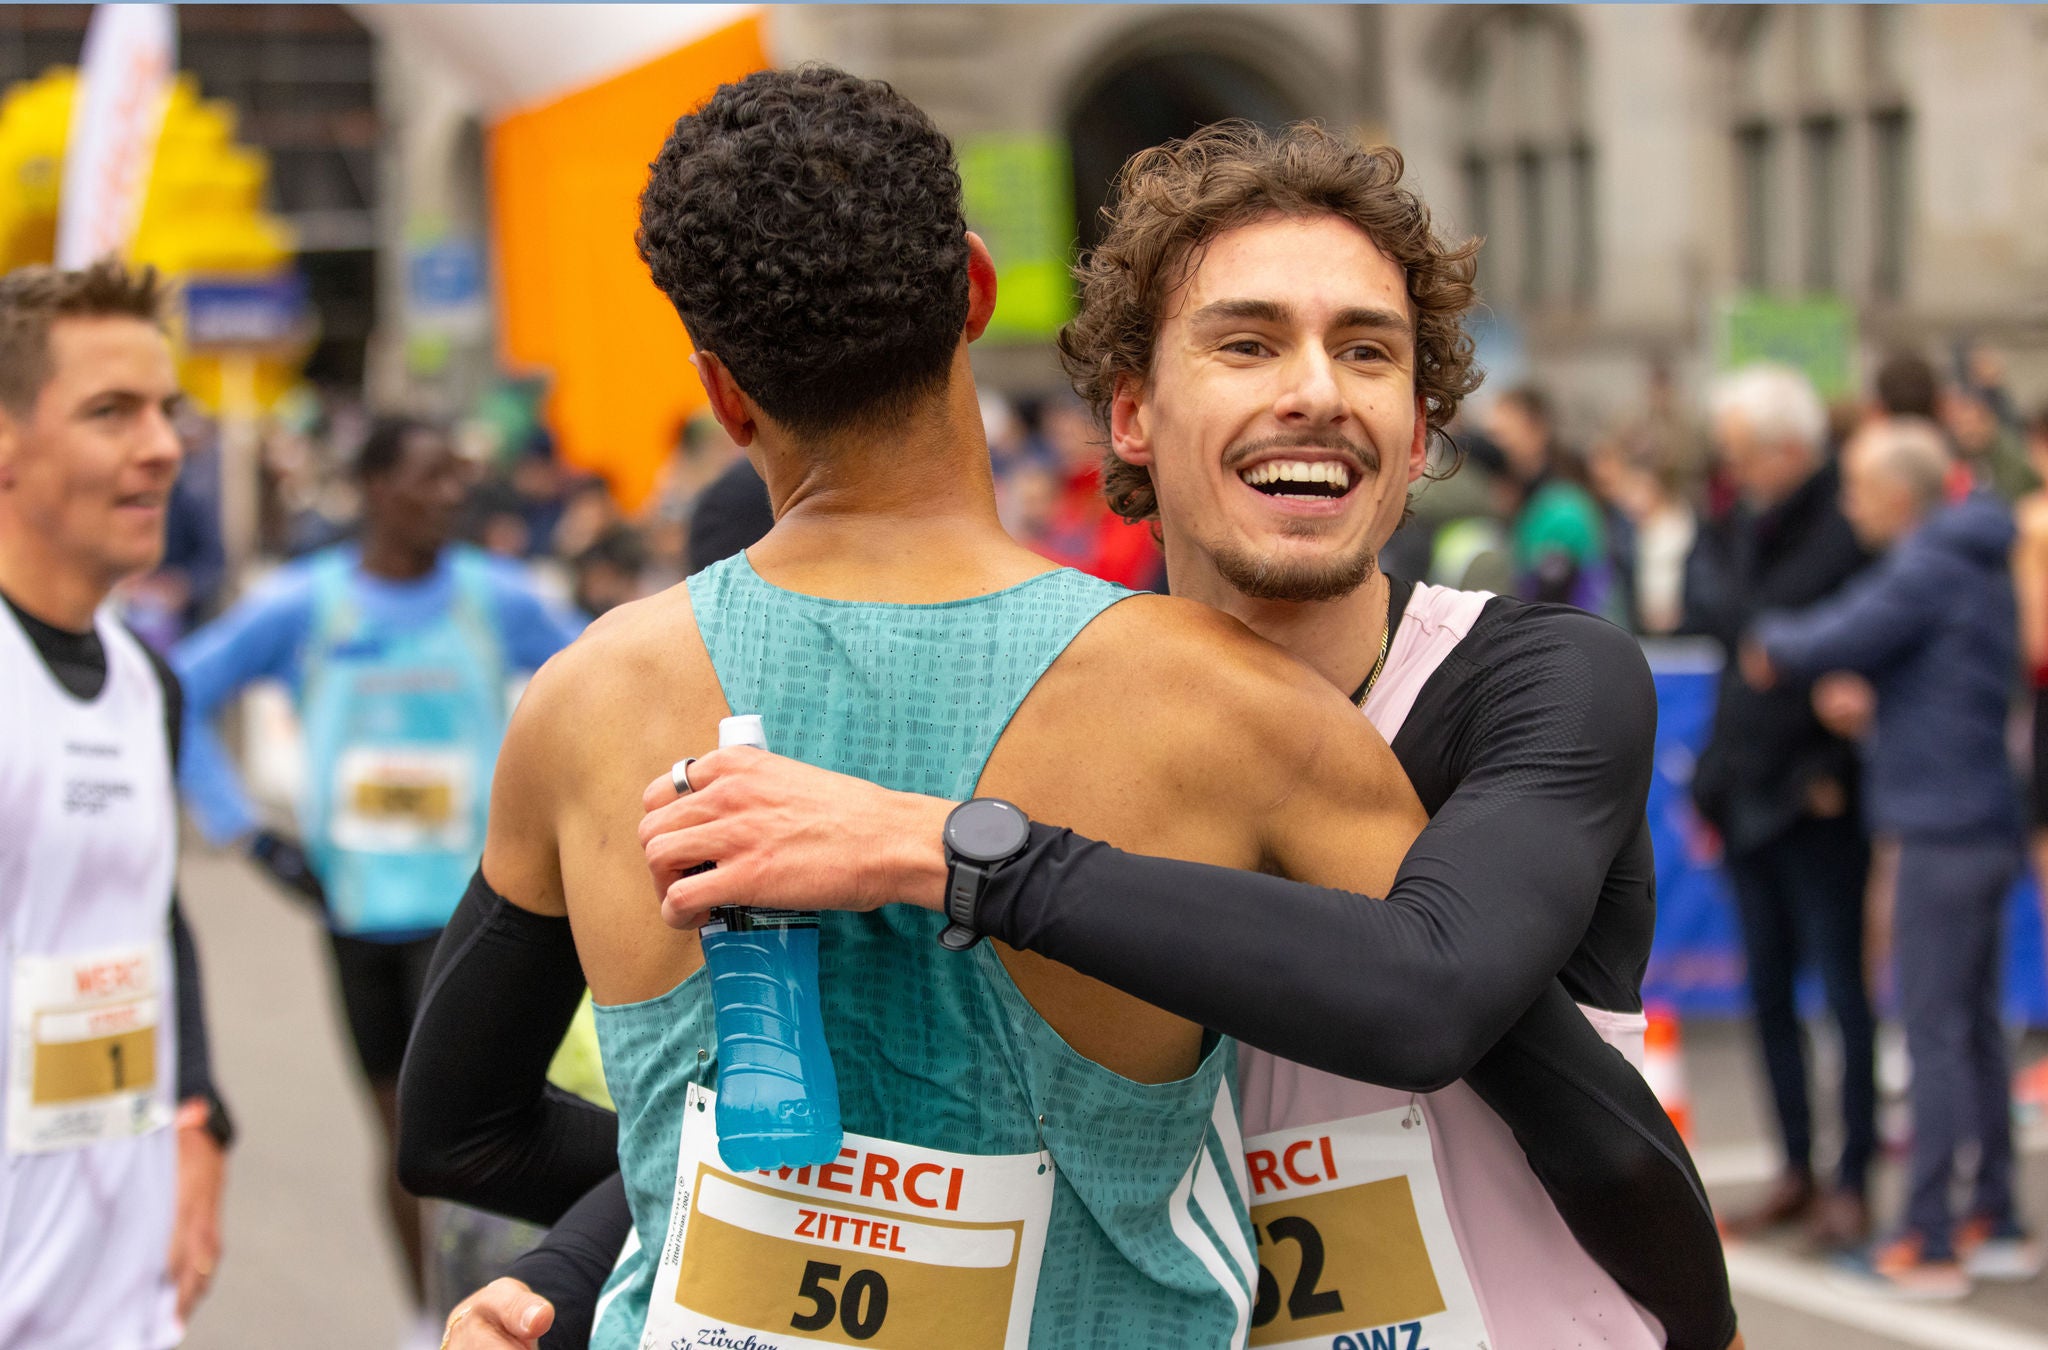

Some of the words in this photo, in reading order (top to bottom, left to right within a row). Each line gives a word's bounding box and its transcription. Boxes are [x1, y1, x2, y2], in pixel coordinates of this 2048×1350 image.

[108, 1042, 125, 1091] 1
[682, 1190, 690, 1211] 2002
[794, 1209, 906, 1253] ZITTEL
[789, 1260, 889, 1340] 50
